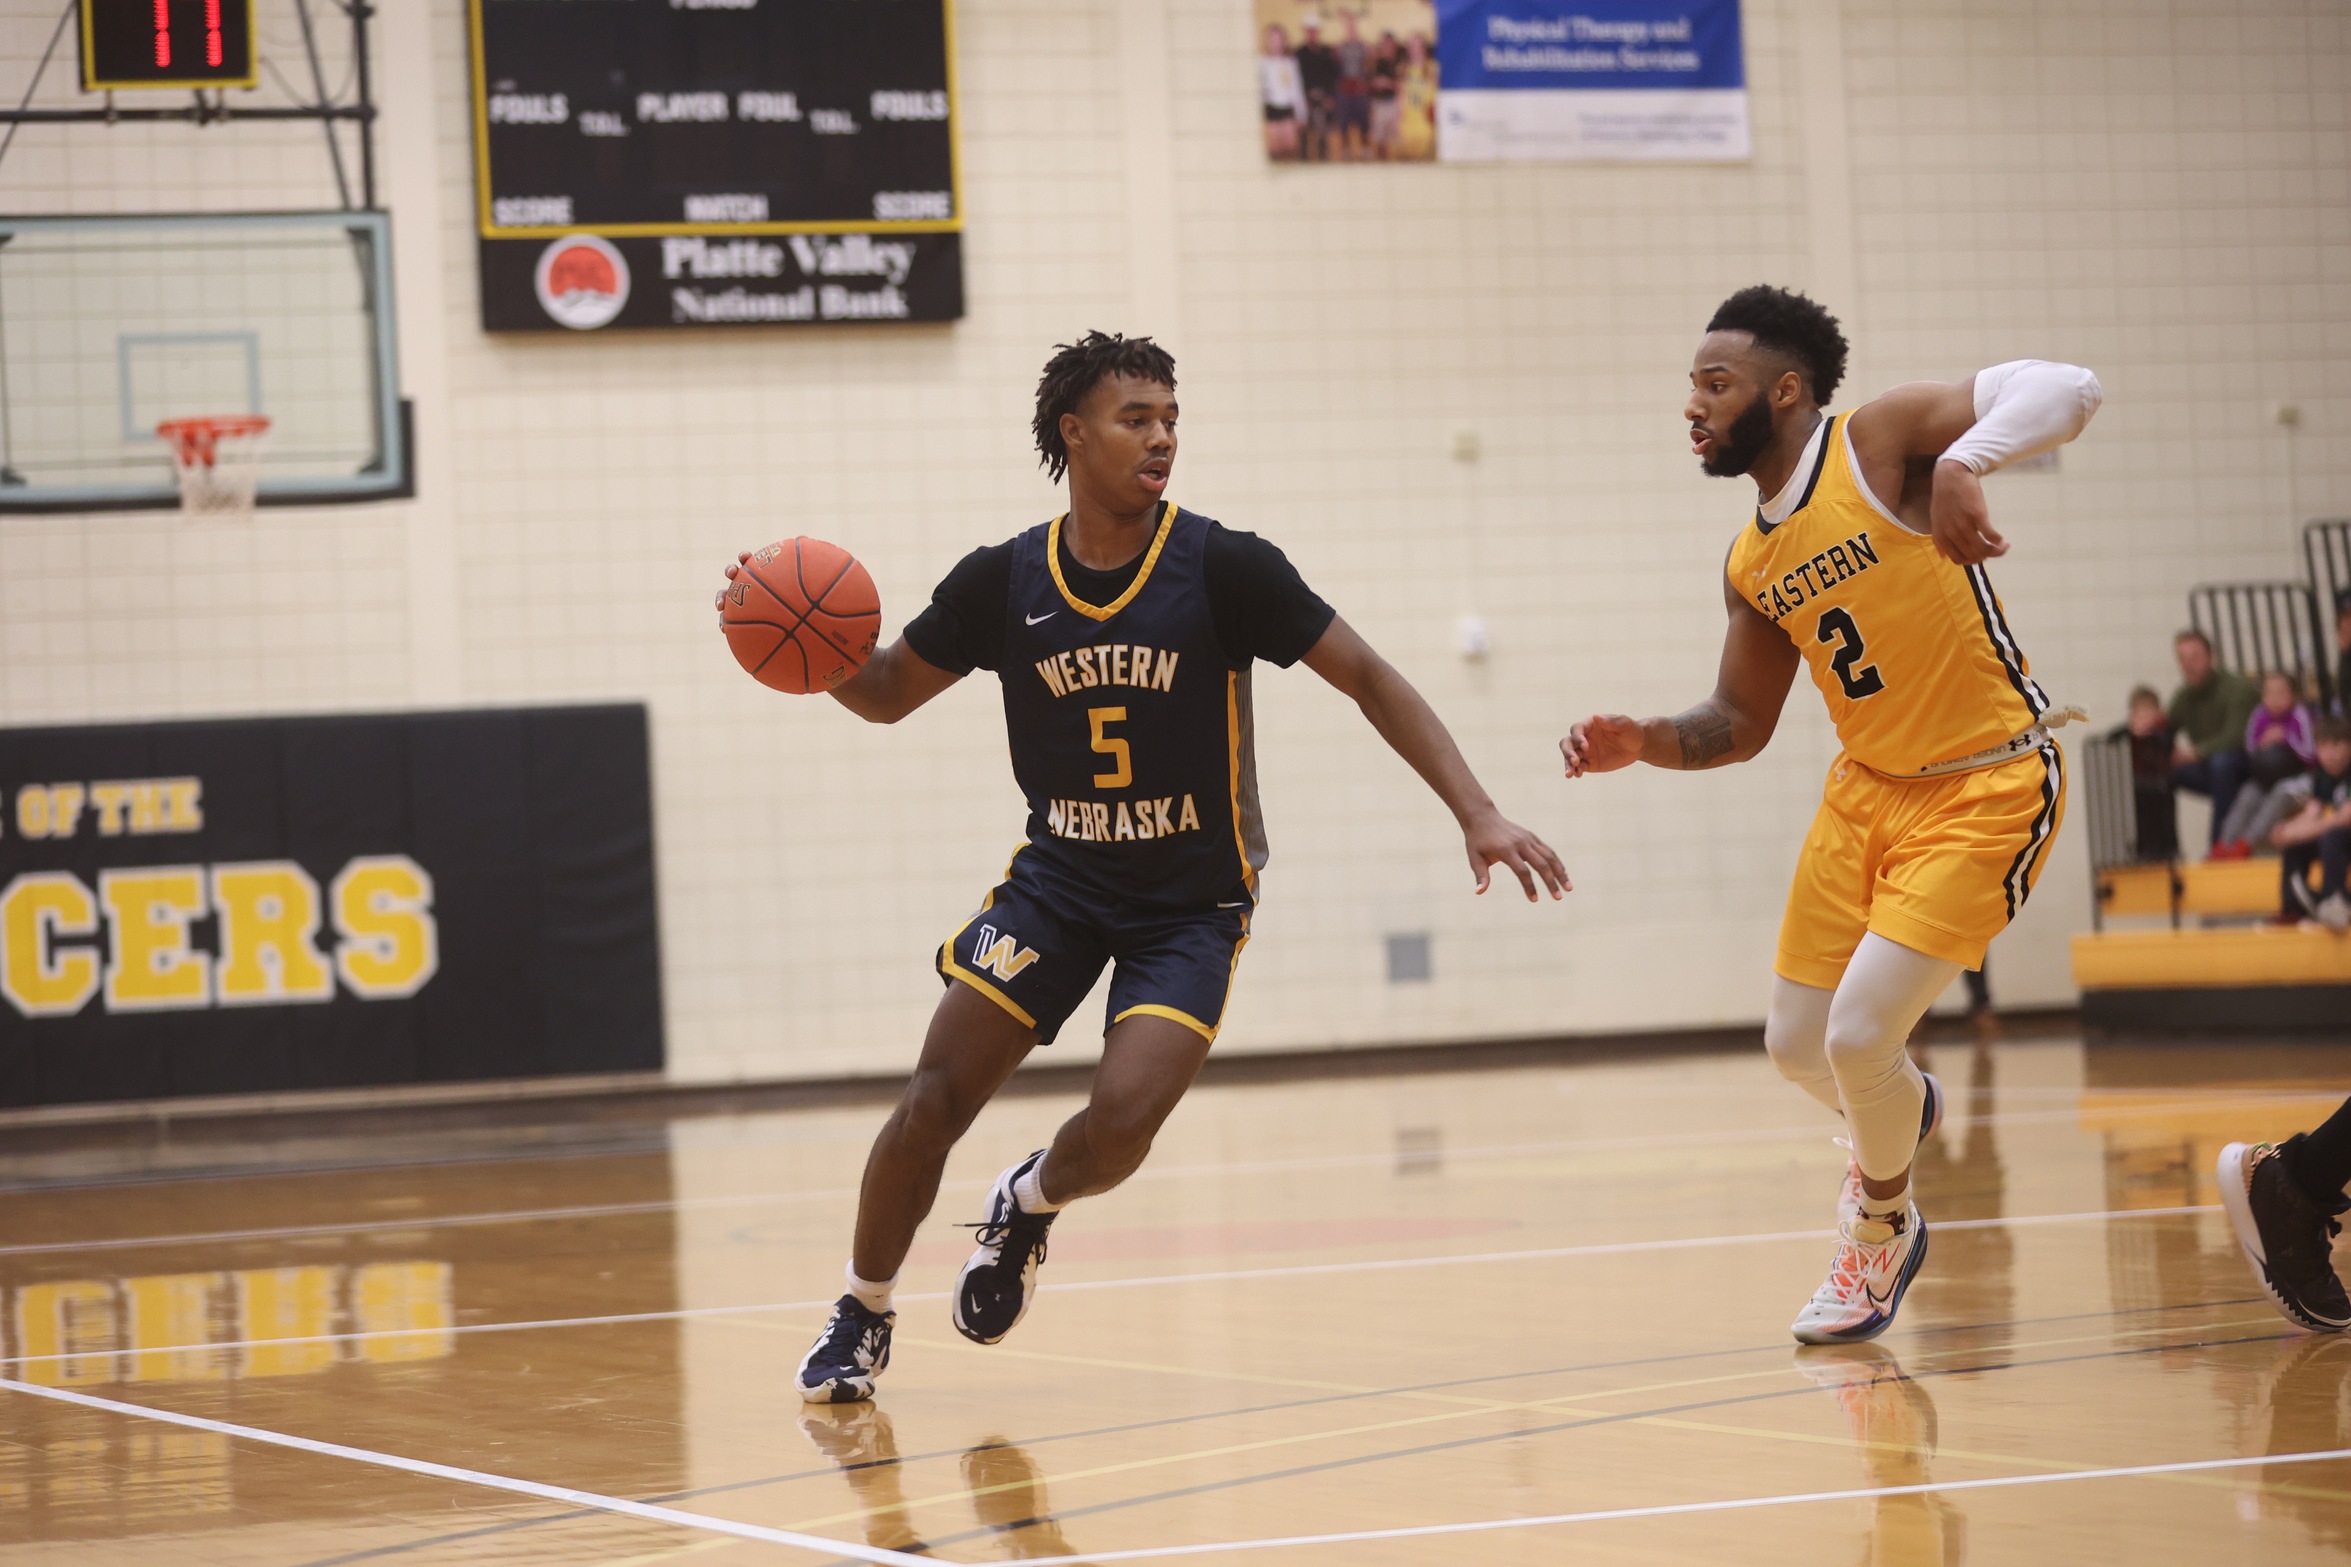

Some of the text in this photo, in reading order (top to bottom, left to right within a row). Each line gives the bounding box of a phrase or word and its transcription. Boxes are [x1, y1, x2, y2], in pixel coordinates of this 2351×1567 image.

[489, 93, 569, 123] FOULS
[636, 91, 803, 123] PLAYER FOUL
[870, 91, 948, 120] FOULS
[493, 196, 573, 226] SCORE
[684, 194, 769, 223] MATCH
[873, 191, 951, 220] SCORE
[662, 233, 916, 285] Platte Valley
[672, 283, 909, 323] National Bank
[1756, 531, 1880, 623] EASTERN
[1034, 644, 1179, 698] WESTERN
[1816, 606, 1889, 700] 2
[1088, 706, 1133, 789] 5
[16, 776, 204, 840] OF THE
[1047, 793, 1201, 842] NEBRASKA
[0, 854, 440, 1018] CERS
